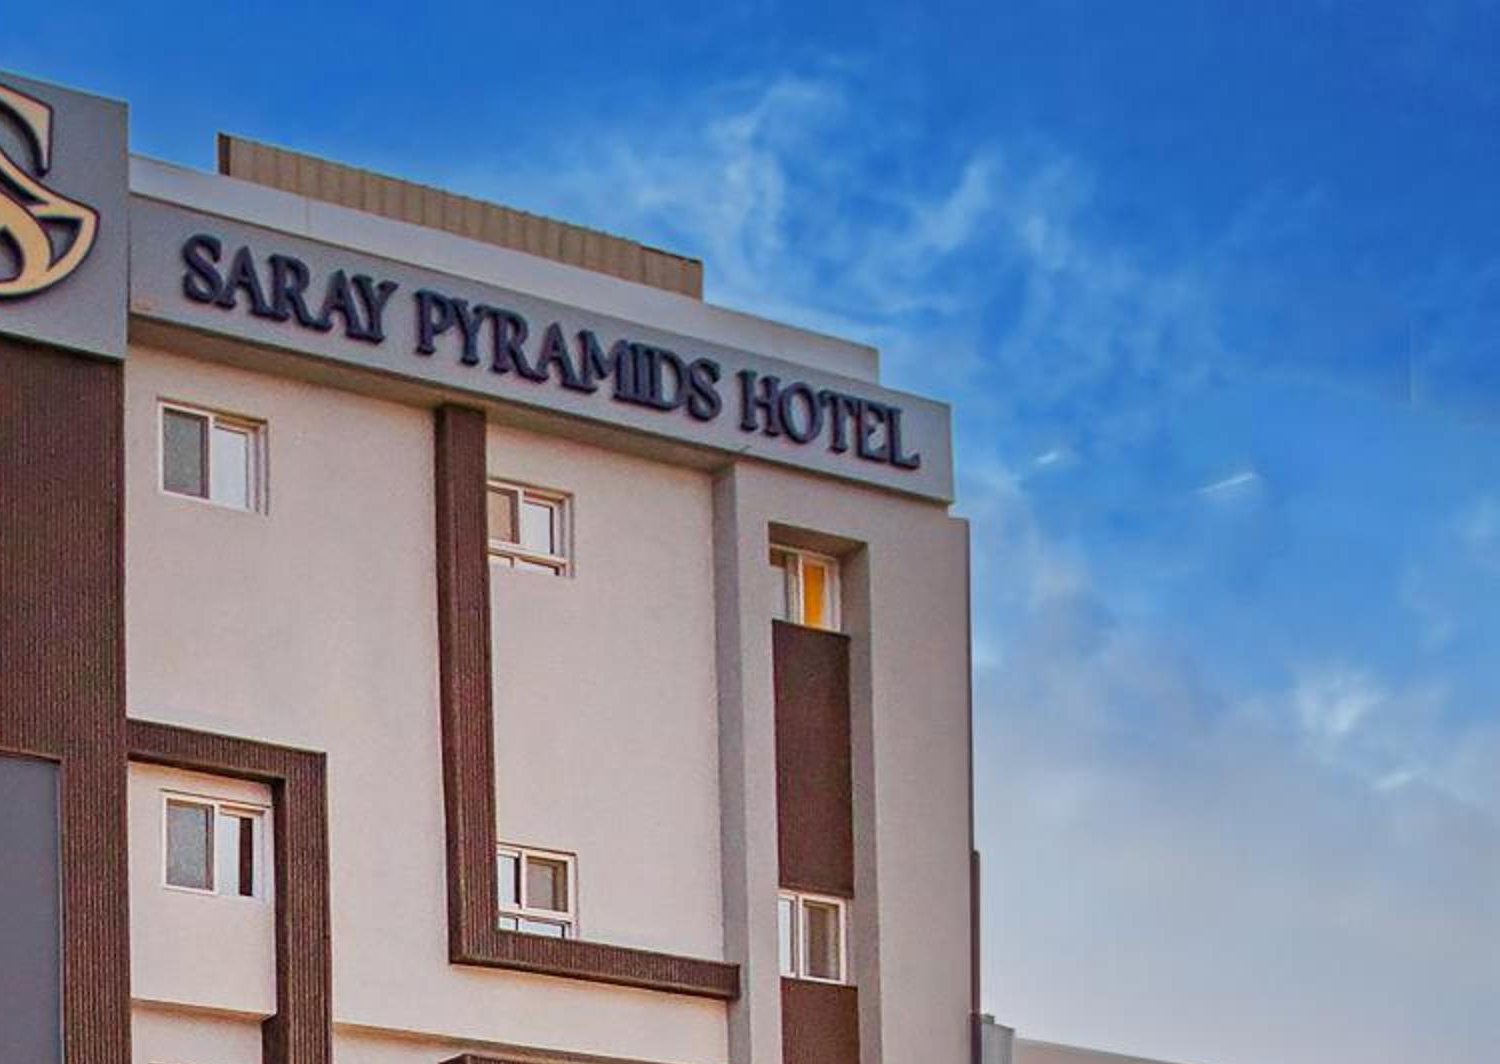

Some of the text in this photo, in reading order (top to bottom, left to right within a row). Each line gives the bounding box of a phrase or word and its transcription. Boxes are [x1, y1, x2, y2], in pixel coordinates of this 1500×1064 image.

[181, 233, 921, 470] SARAY PYRAMIDS HOTEL
